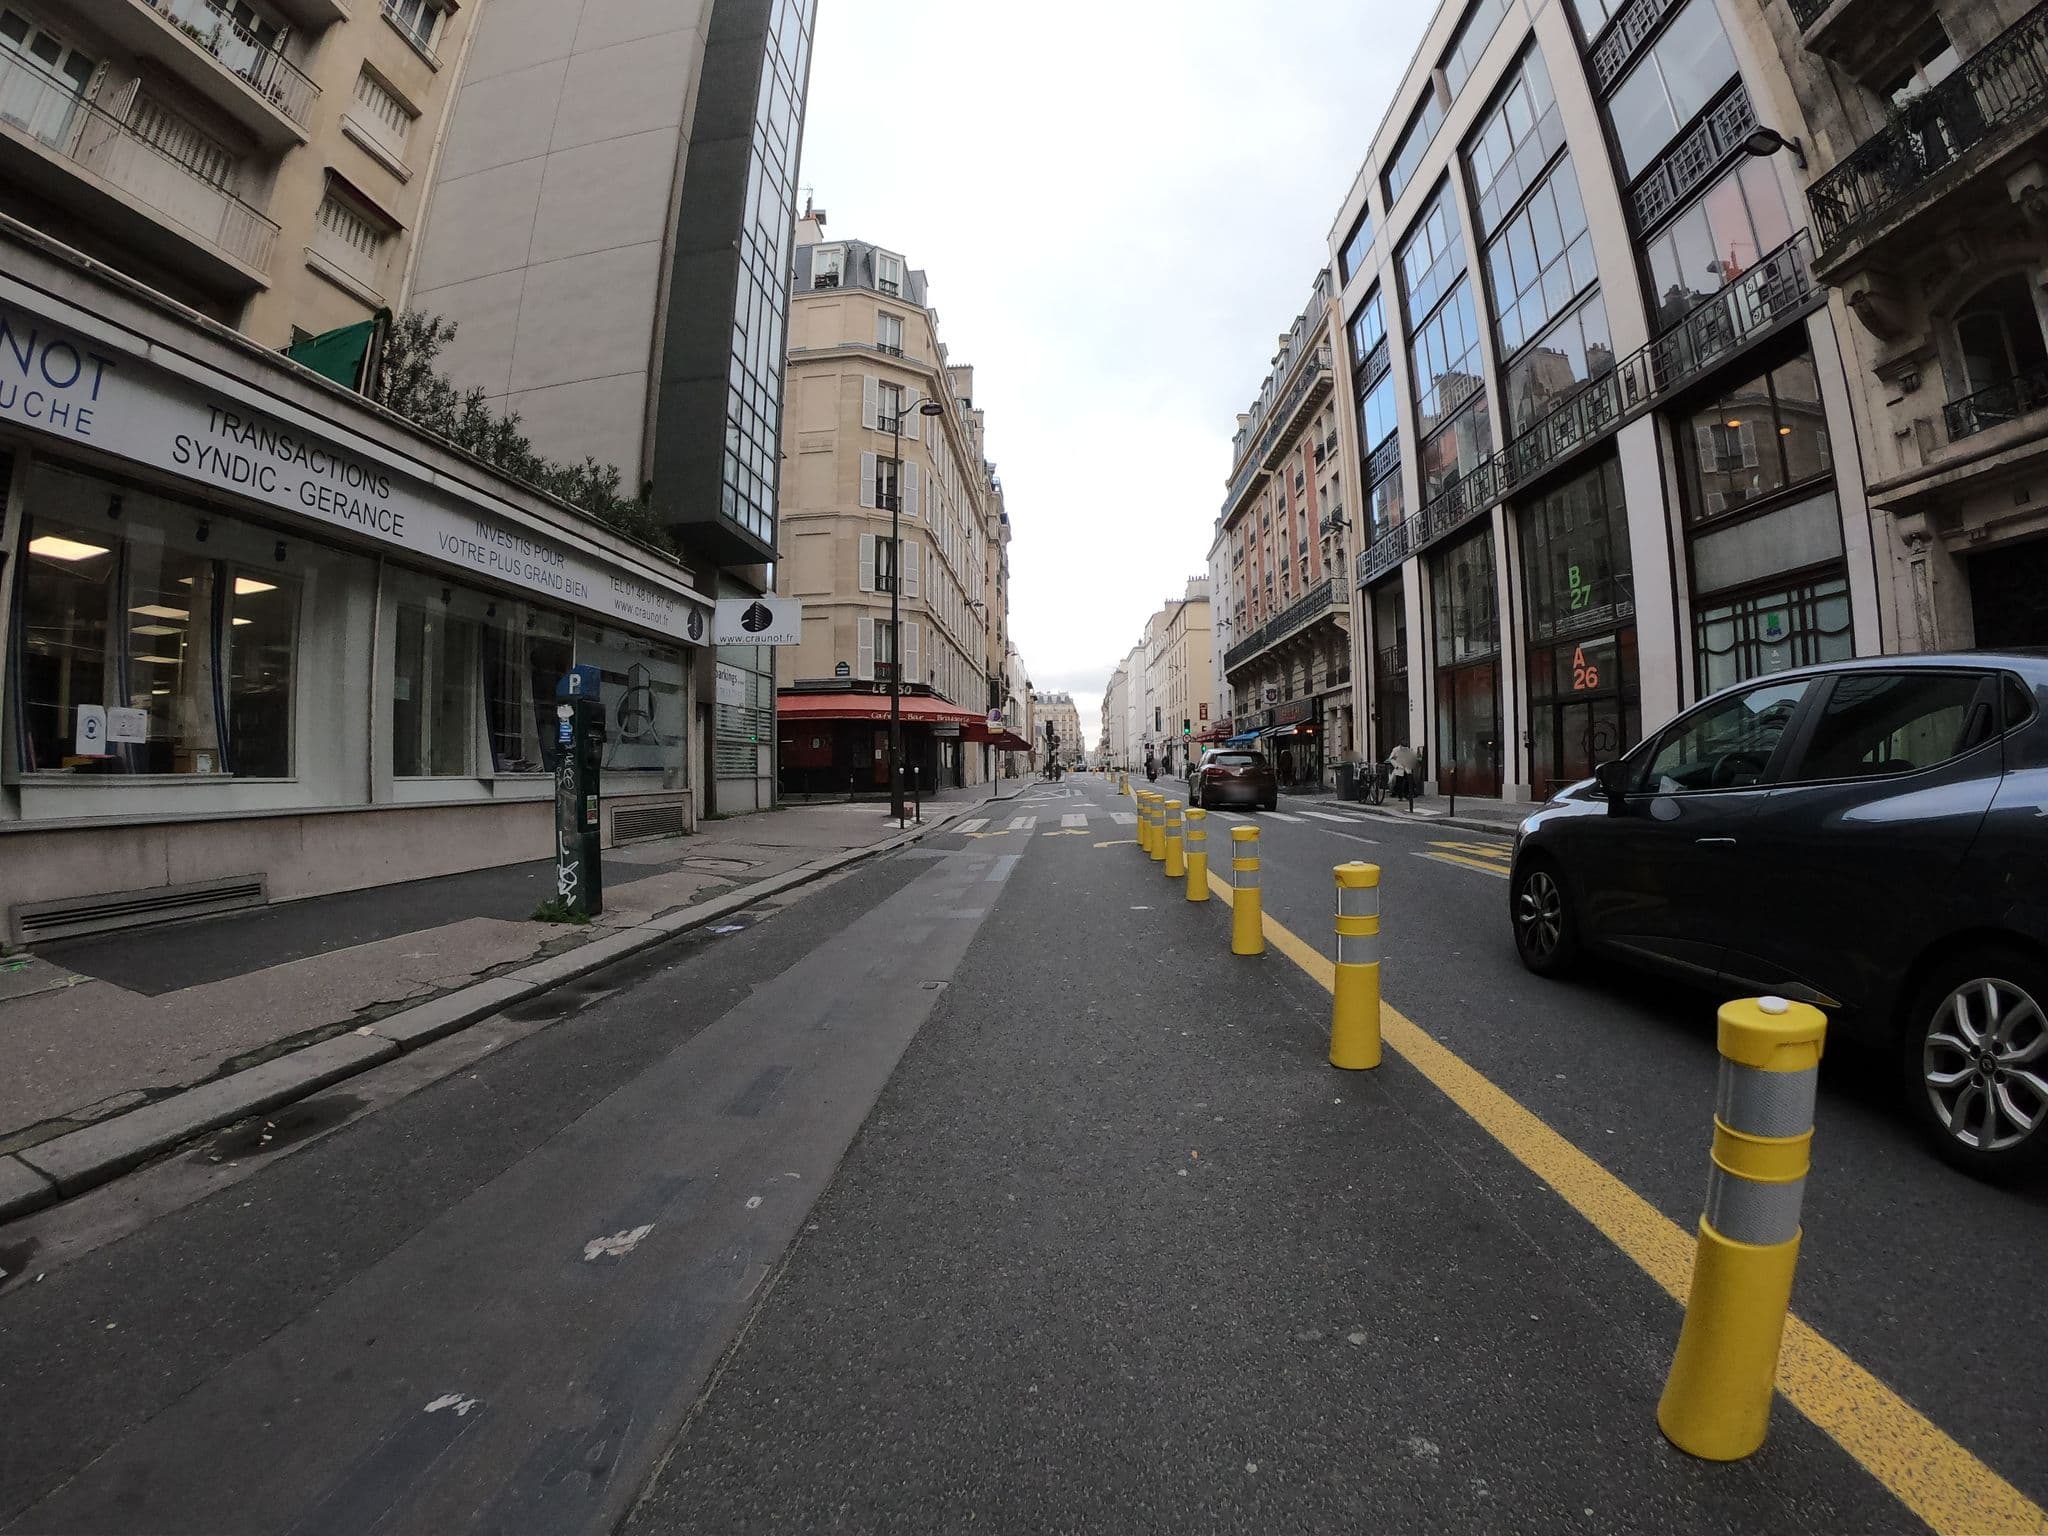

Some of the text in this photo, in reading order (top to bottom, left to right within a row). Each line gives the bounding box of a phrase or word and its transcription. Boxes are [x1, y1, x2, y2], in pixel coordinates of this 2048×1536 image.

[206, 404, 391, 499] TRANSACTIONS
[172, 434, 277, 493] SYNDIC
[299, 480, 405, 538] GERANCE
[475, 521, 565, 569] INVESTIS POUR
[438, 531, 589, 600] VOTRE PLUS GRAND BIEN
[1568, 565, 1581, 589] B
[609, 575, 625, 594] TEL
[1570, 584, 1592, 610] 27
[614, 599, 669, 626] www.craunot.fr
[719, 633, 794, 644] www.craunot.fr
[1573, 646, 1586, 669] A
[568, 673, 582, 695] P
[872, 683, 888, 694] LE
[1573, 666, 1599, 690] 26
